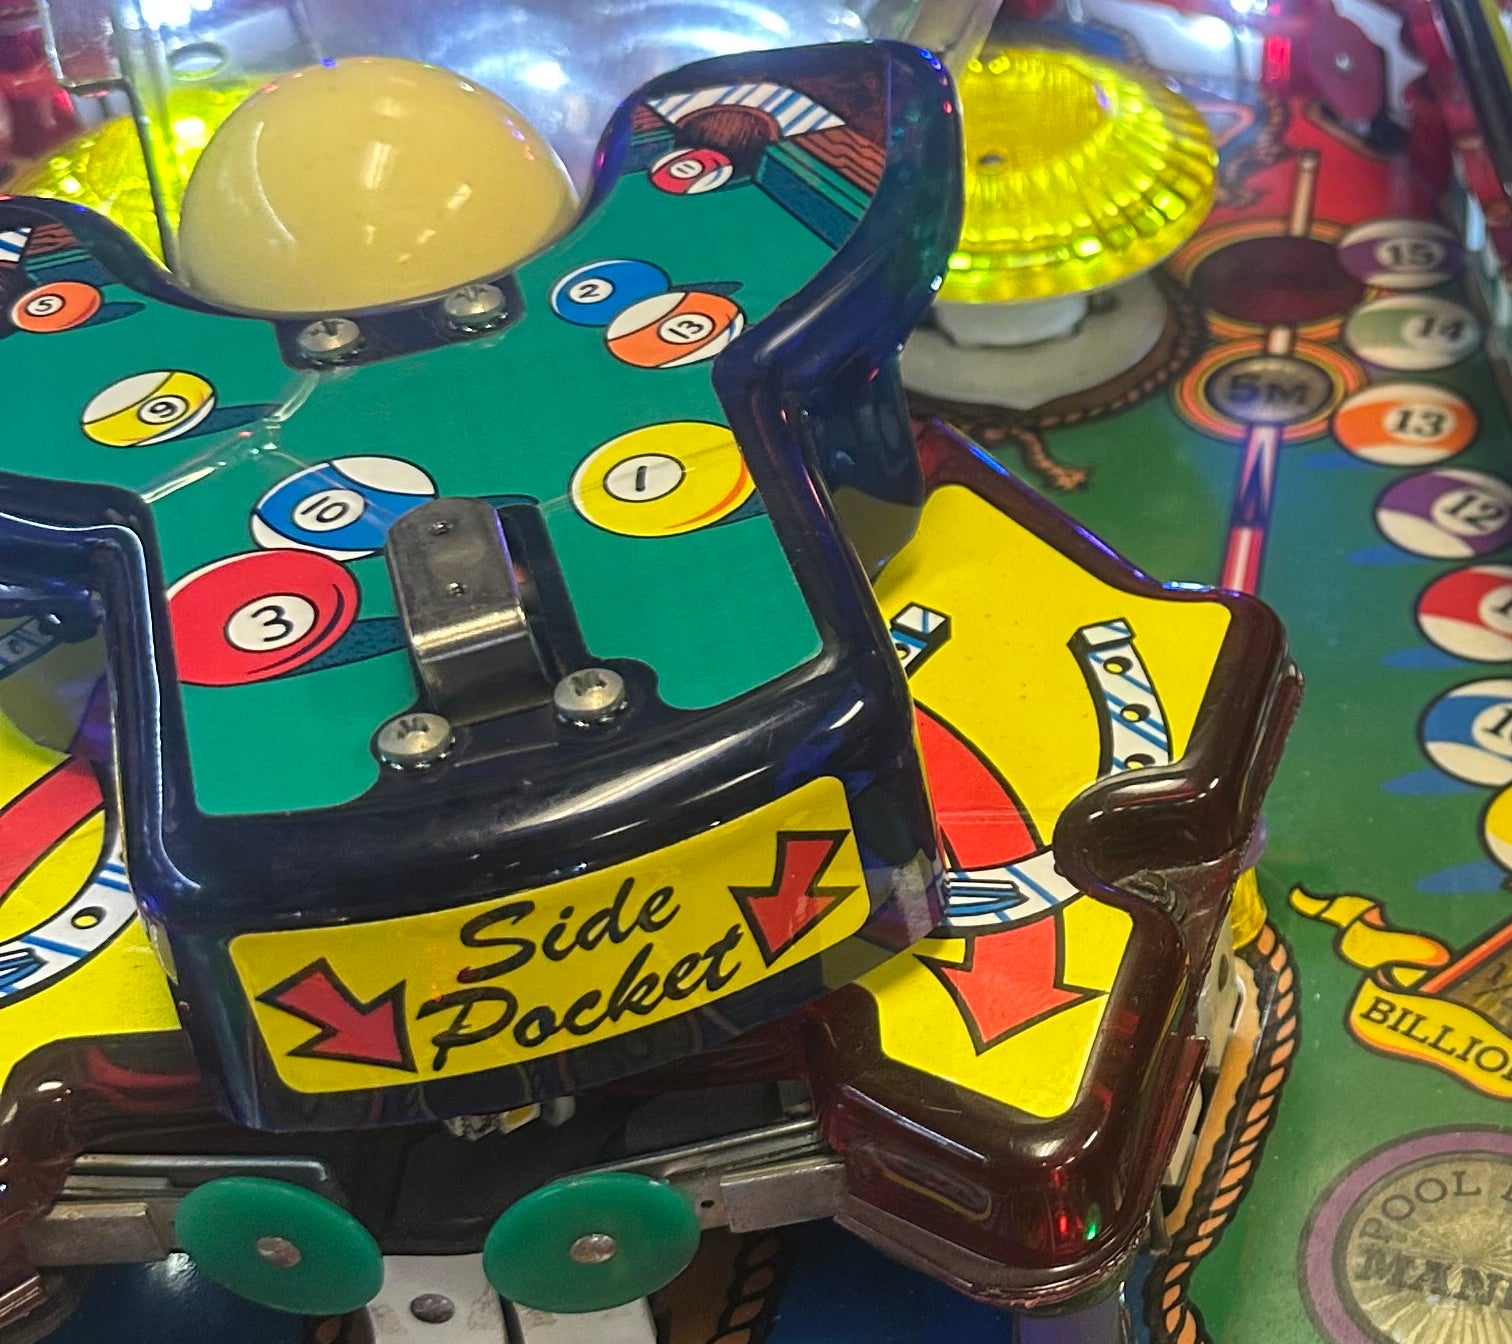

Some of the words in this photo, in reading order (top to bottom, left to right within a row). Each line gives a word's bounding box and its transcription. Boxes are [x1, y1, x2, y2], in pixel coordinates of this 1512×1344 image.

[34, 297, 54, 313] 5
[577, 283, 601, 301] 2
[1417, 314, 1465, 344] 14
[1391, 407, 1446, 439] 13
[300, 495, 350, 524] 10
[1442, 494, 1505, 533] 12
[250, 604, 296, 643] 3
[456, 876, 681, 984] Side
[416, 923, 744, 1071] Pocket
[1358, 1169, 1483, 1244] POOL
